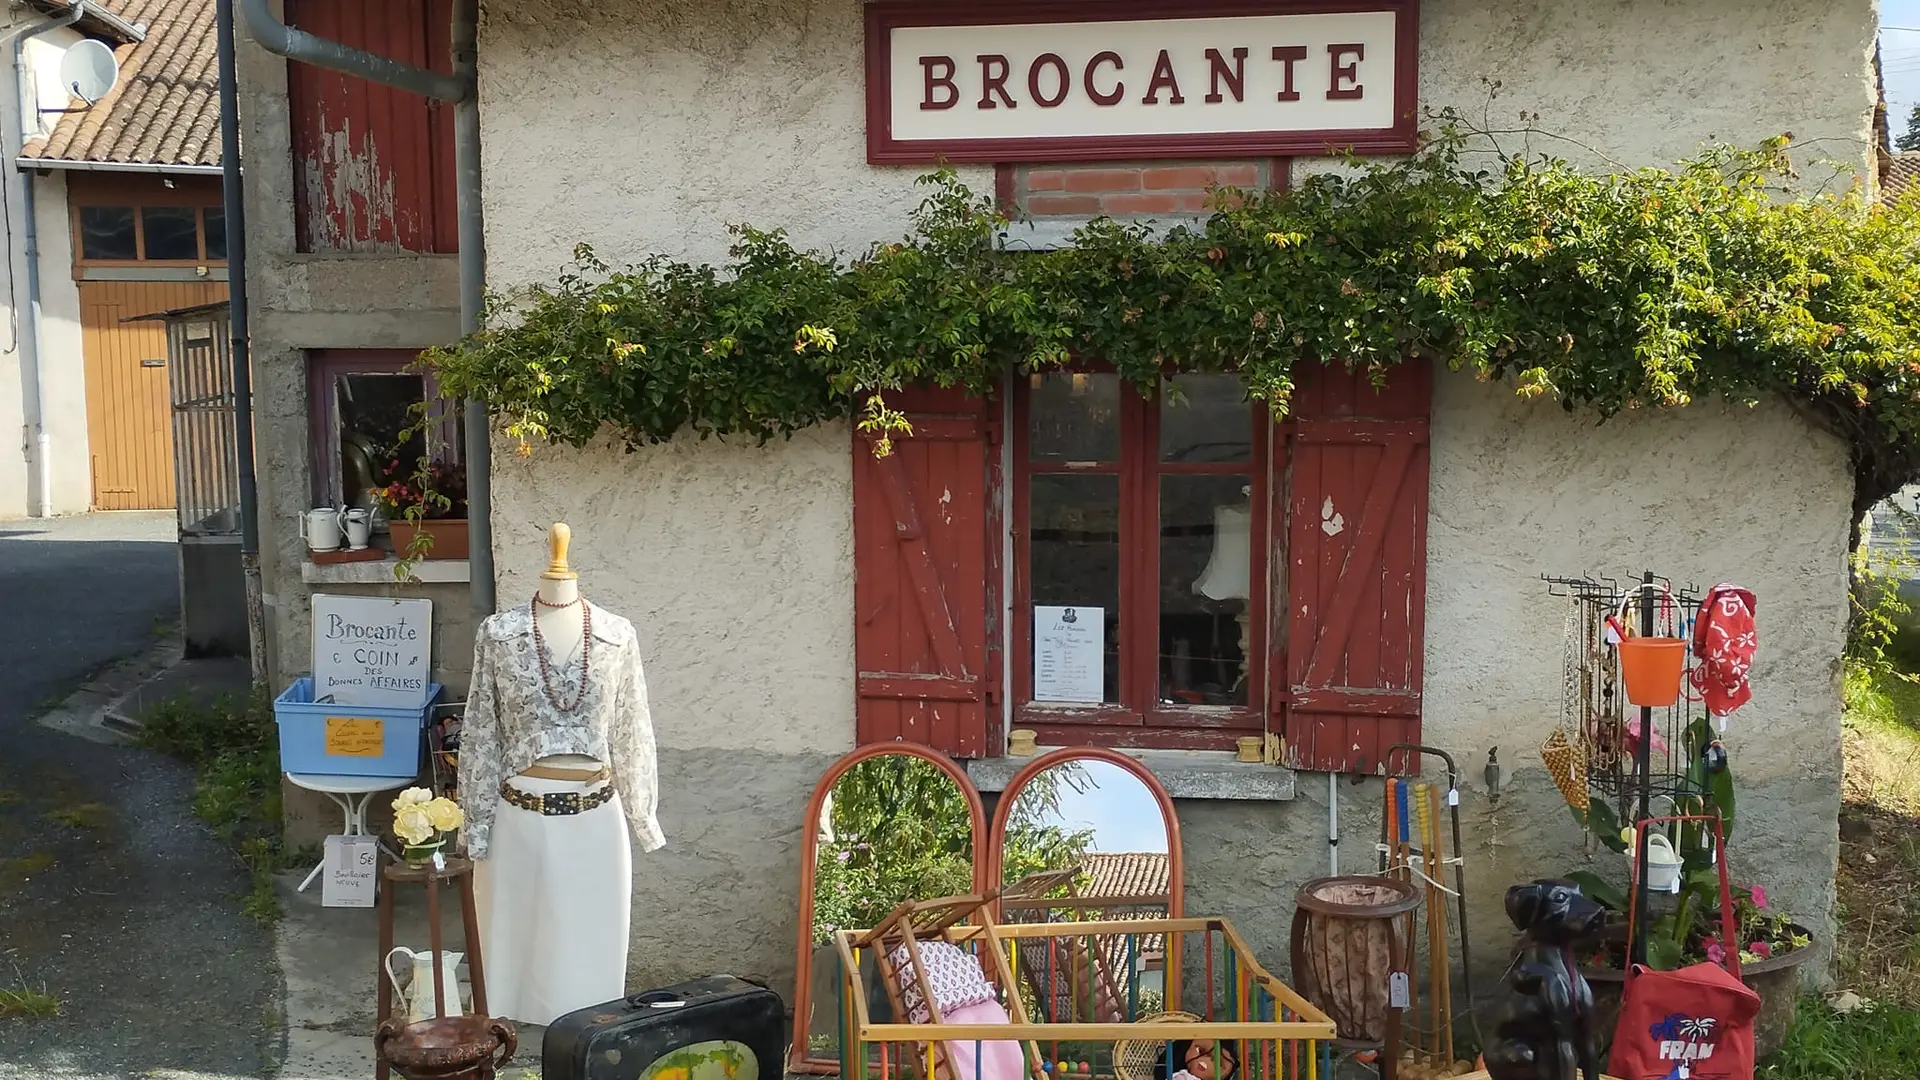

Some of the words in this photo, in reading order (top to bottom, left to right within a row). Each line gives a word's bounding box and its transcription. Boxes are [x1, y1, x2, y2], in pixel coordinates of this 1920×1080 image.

[918, 43, 1365, 111] BROCANTE
[325, 613, 417, 640] Brocante
[353, 648, 399, 666] COIN
[364, 667, 383, 676] DES
[370, 677, 421, 689] AFFAIRES
